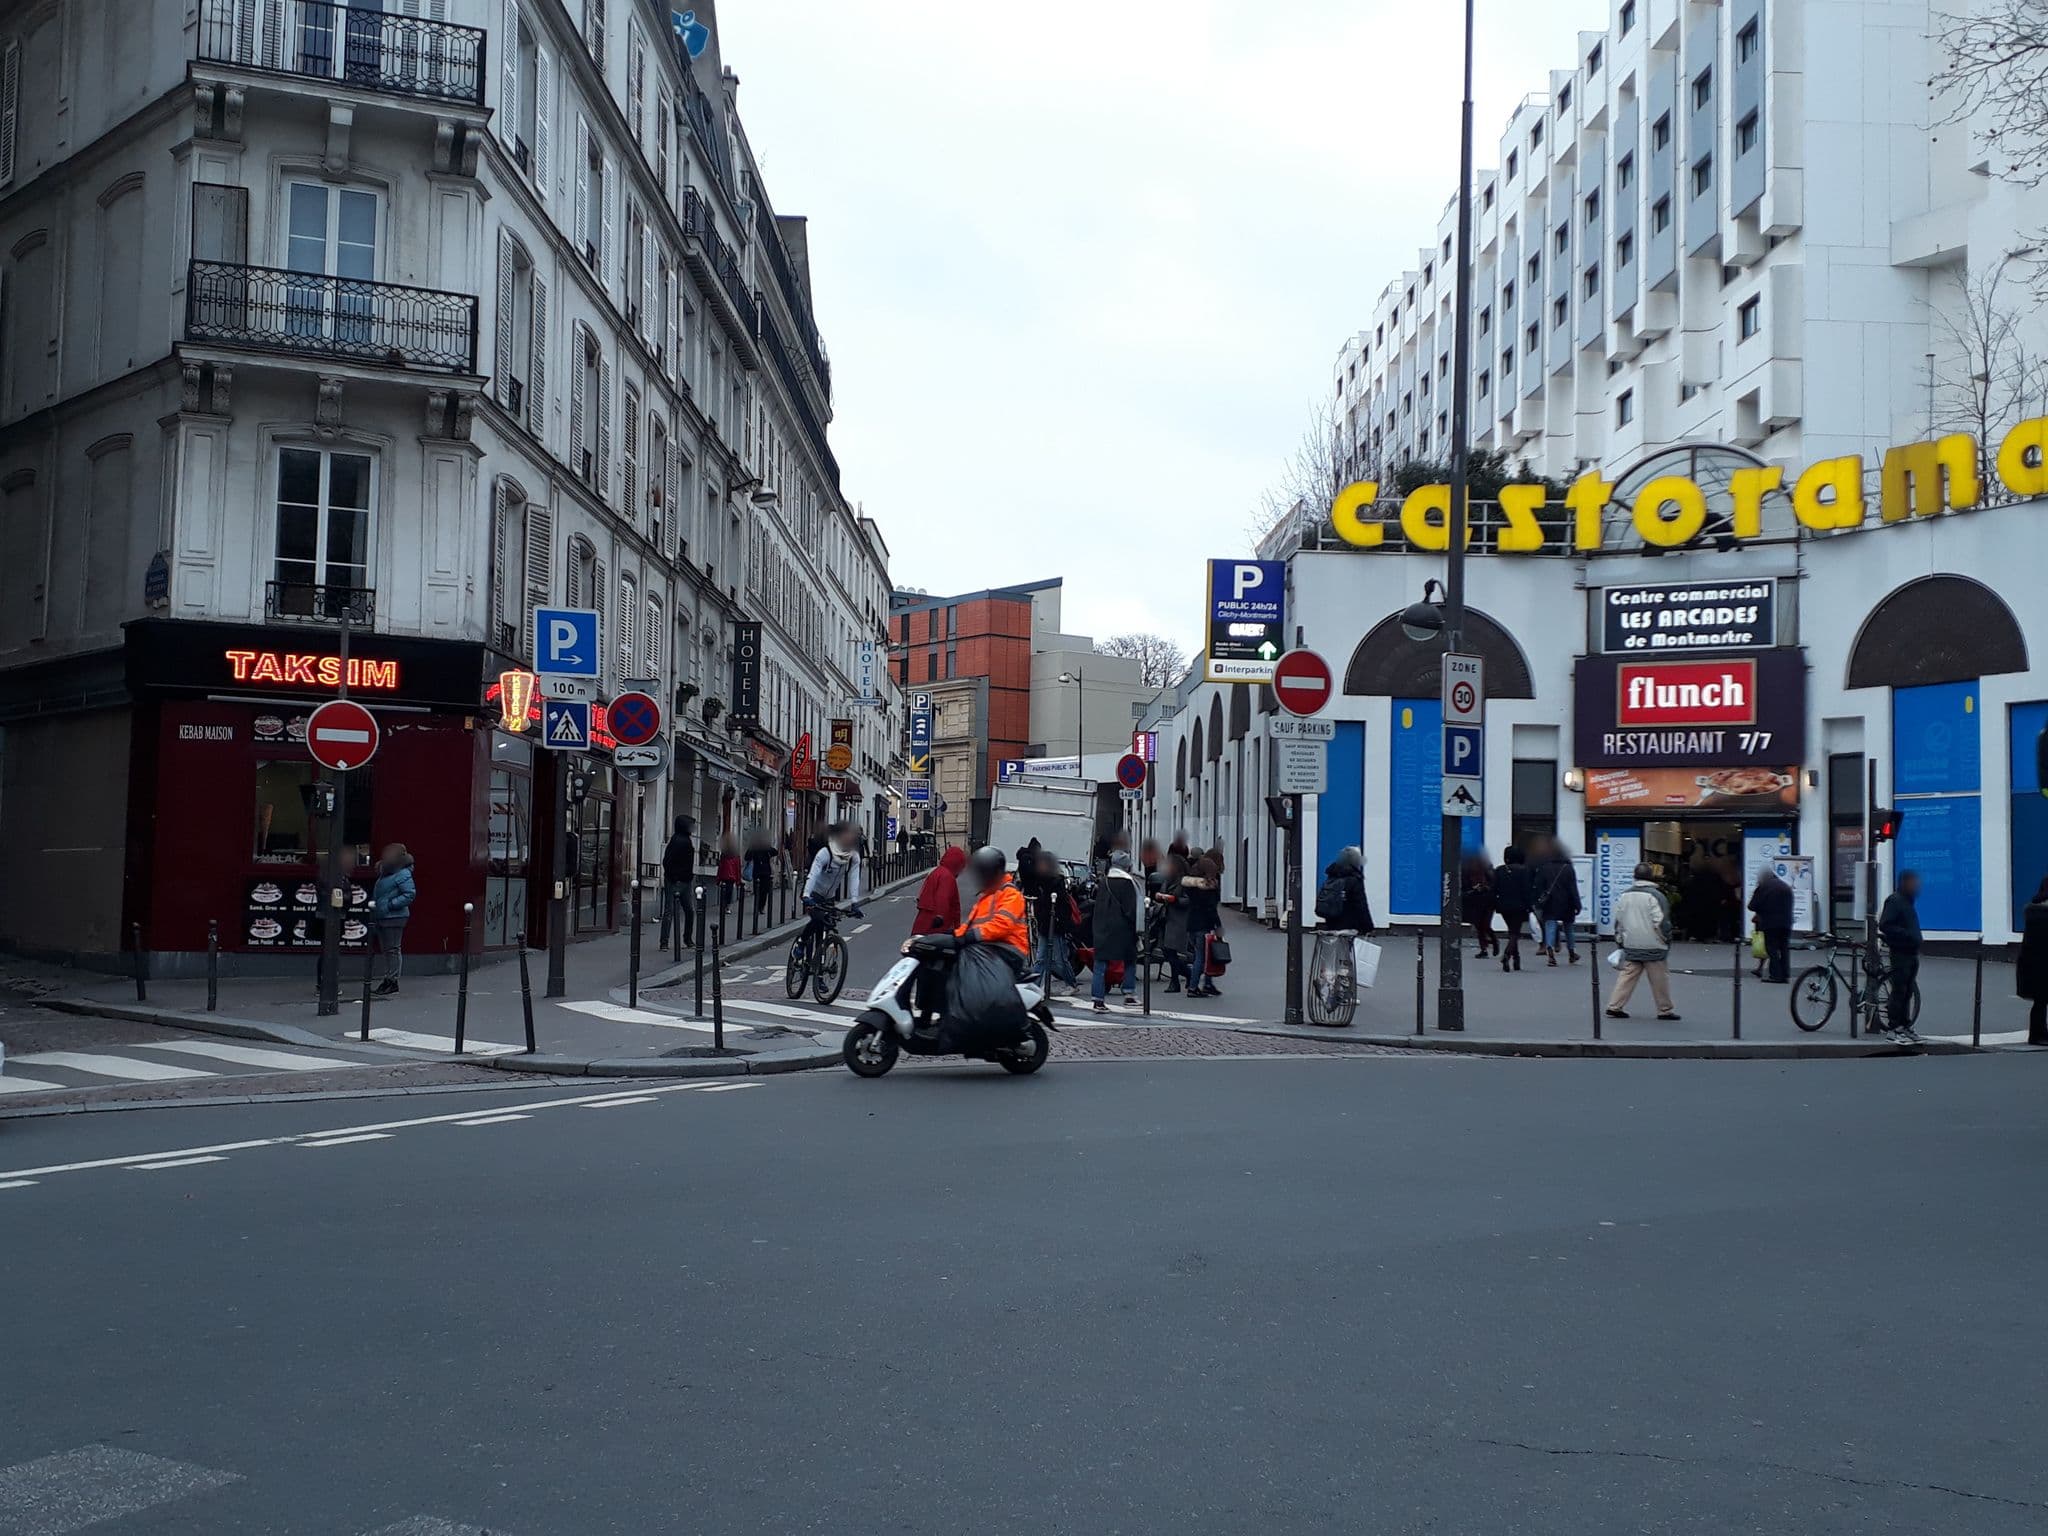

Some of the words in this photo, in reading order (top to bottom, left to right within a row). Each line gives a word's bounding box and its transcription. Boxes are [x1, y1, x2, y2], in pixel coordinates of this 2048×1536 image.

[1233, 565, 1263, 599] P
[1610, 591, 1664, 605] Centre
[1668, 584, 1769, 602] commercial
[1218, 601, 1249, 609] PUBLIC
[1250, 602, 1277, 611] 24h/24
[1621, 611, 1652, 628] LES
[1658, 606, 1758, 627] ARCADES
[550, 619, 578, 661] P
[1624, 635, 1647, 648] de
[1651, 630, 1753, 647] Montmartre
[226, 650, 397, 688] TAKSIM
[741, 629, 754, 707] HOTEL
[862, 642, 871, 697] HOTEL
[1225, 664, 1274, 675] Interparkin
[1452, 663, 1477, 674] ZONE
[553, 682, 575, 695] 100
[577, 688, 585, 696] m
[1456, 691, 1471, 704] 30
[1628, 674, 1745, 709] flunch
[916, 695, 926, 708] P
[179, 725, 203, 740] KEBAB
[204, 726, 233, 740] MAISON
[1274, 721, 1295, 734] SAUF
[1298, 723, 1331, 735] PARKING
[1453, 736, 1471, 767] P
[1603, 731, 1726, 755] RESTAURANT
[1738, 731, 1772, 755] 7/7
[1006, 762, 1017, 775] P
[1600, 844, 1611, 925] castorama
